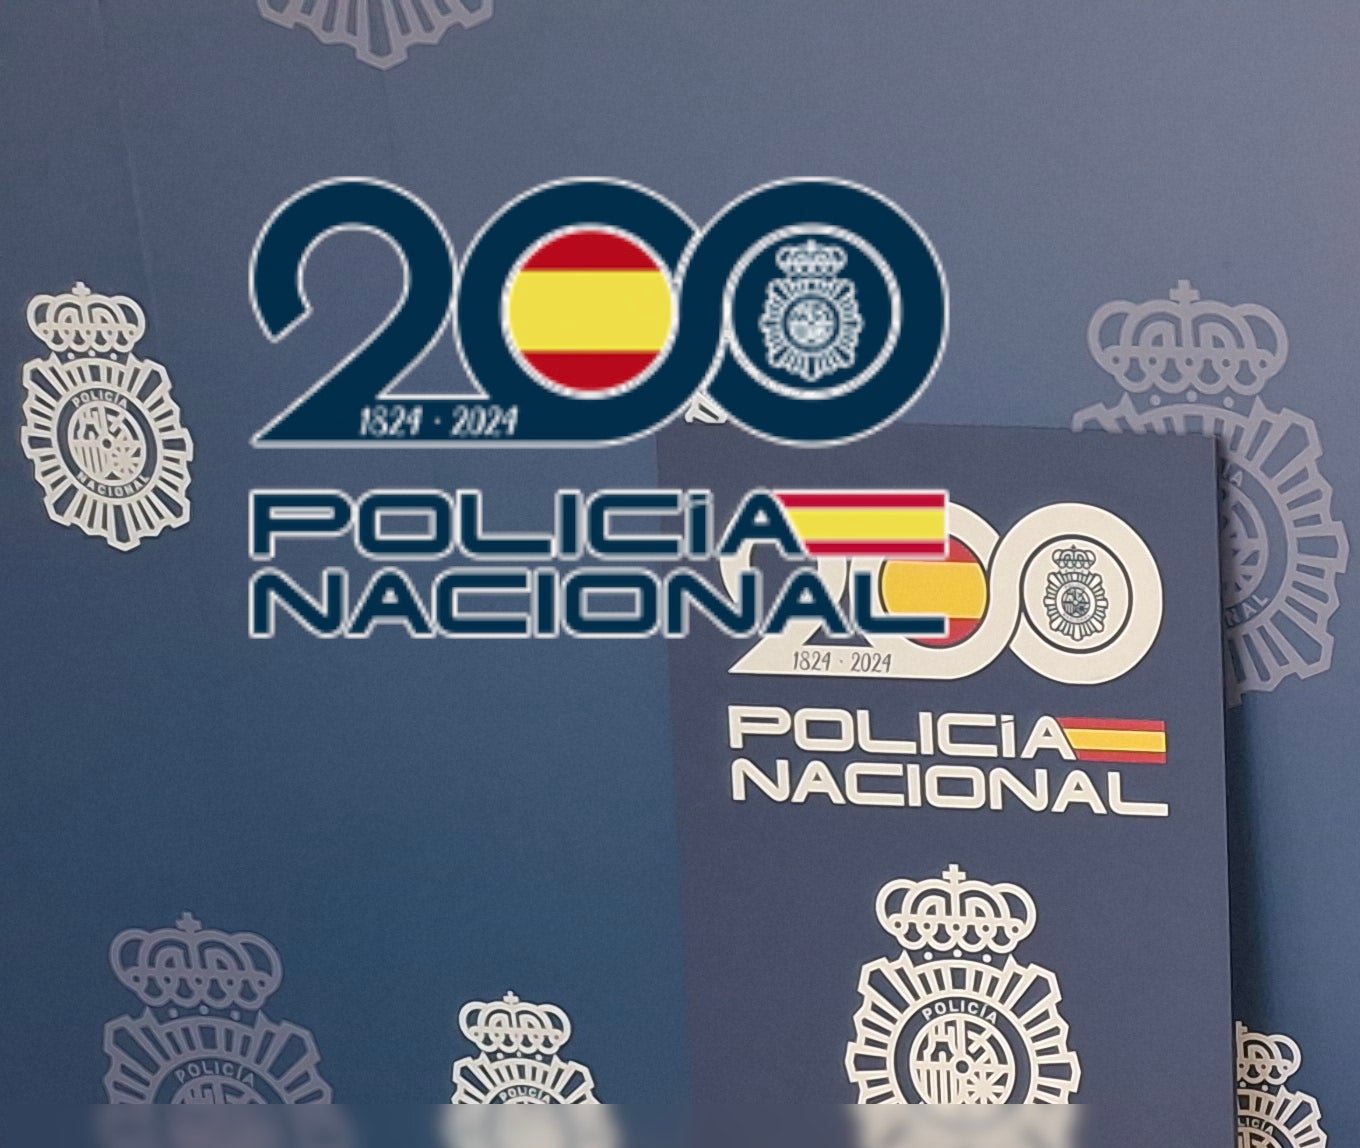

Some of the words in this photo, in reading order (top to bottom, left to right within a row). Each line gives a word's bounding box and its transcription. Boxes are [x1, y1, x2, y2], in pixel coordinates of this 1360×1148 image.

[76, 472, 150, 496] NACIONAL
[792, 649, 831, 672] 1824
[851, 650, 892, 674] 2024
[731, 762, 1169, 817] NACIONAL
[922, 998, 998, 1024] POLICÍA
